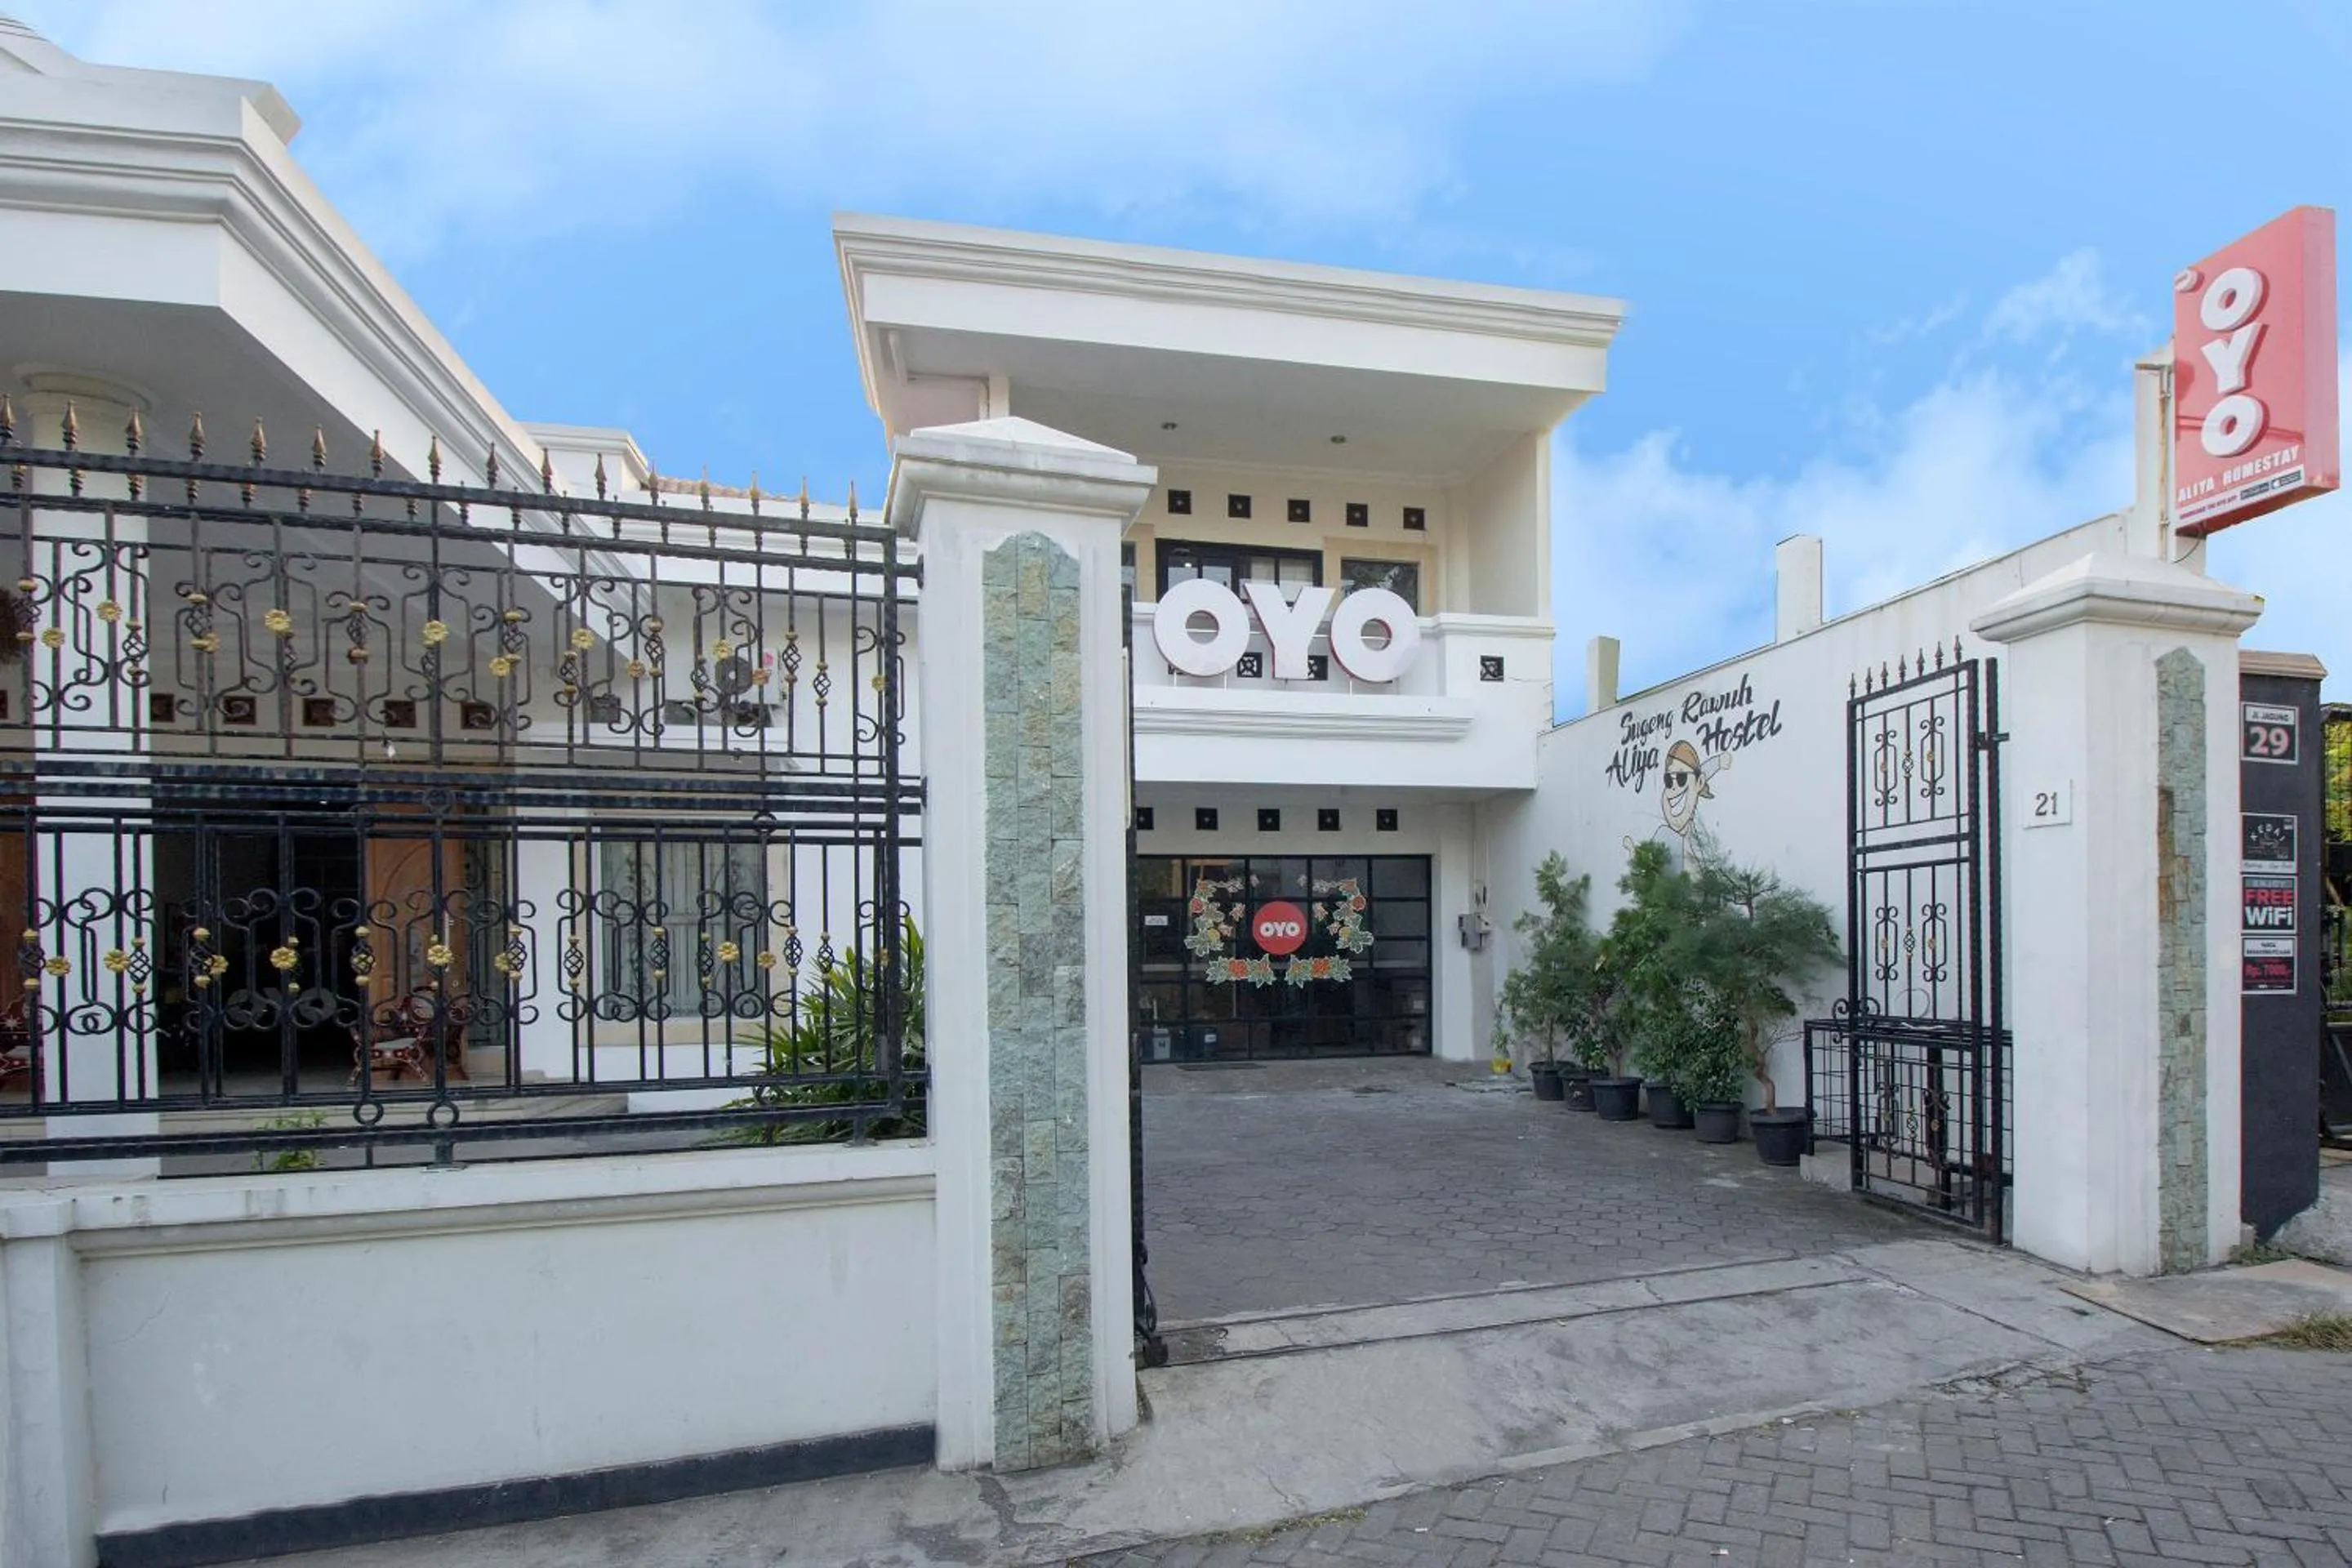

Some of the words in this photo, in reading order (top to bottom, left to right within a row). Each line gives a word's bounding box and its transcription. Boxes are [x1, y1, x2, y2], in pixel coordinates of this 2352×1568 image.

[2200, 267, 2263, 457] OYO
[2222, 445, 2300, 486] HOMESTAY
[1153, 578, 1419, 683] OYO
[1620, 711, 1674, 746] Sugeng
[1681, 673, 1753, 724] Rawuh
[1696, 699, 1782, 755] Hostel
[2250, 725, 2289, 755] 29
[2035, 791, 2058, 816] 21
[2245, 889, 2293, 905] FREE
[1260, 921, 1301, 938] OYO
[2245, 906, 2293, 926] WiFi
